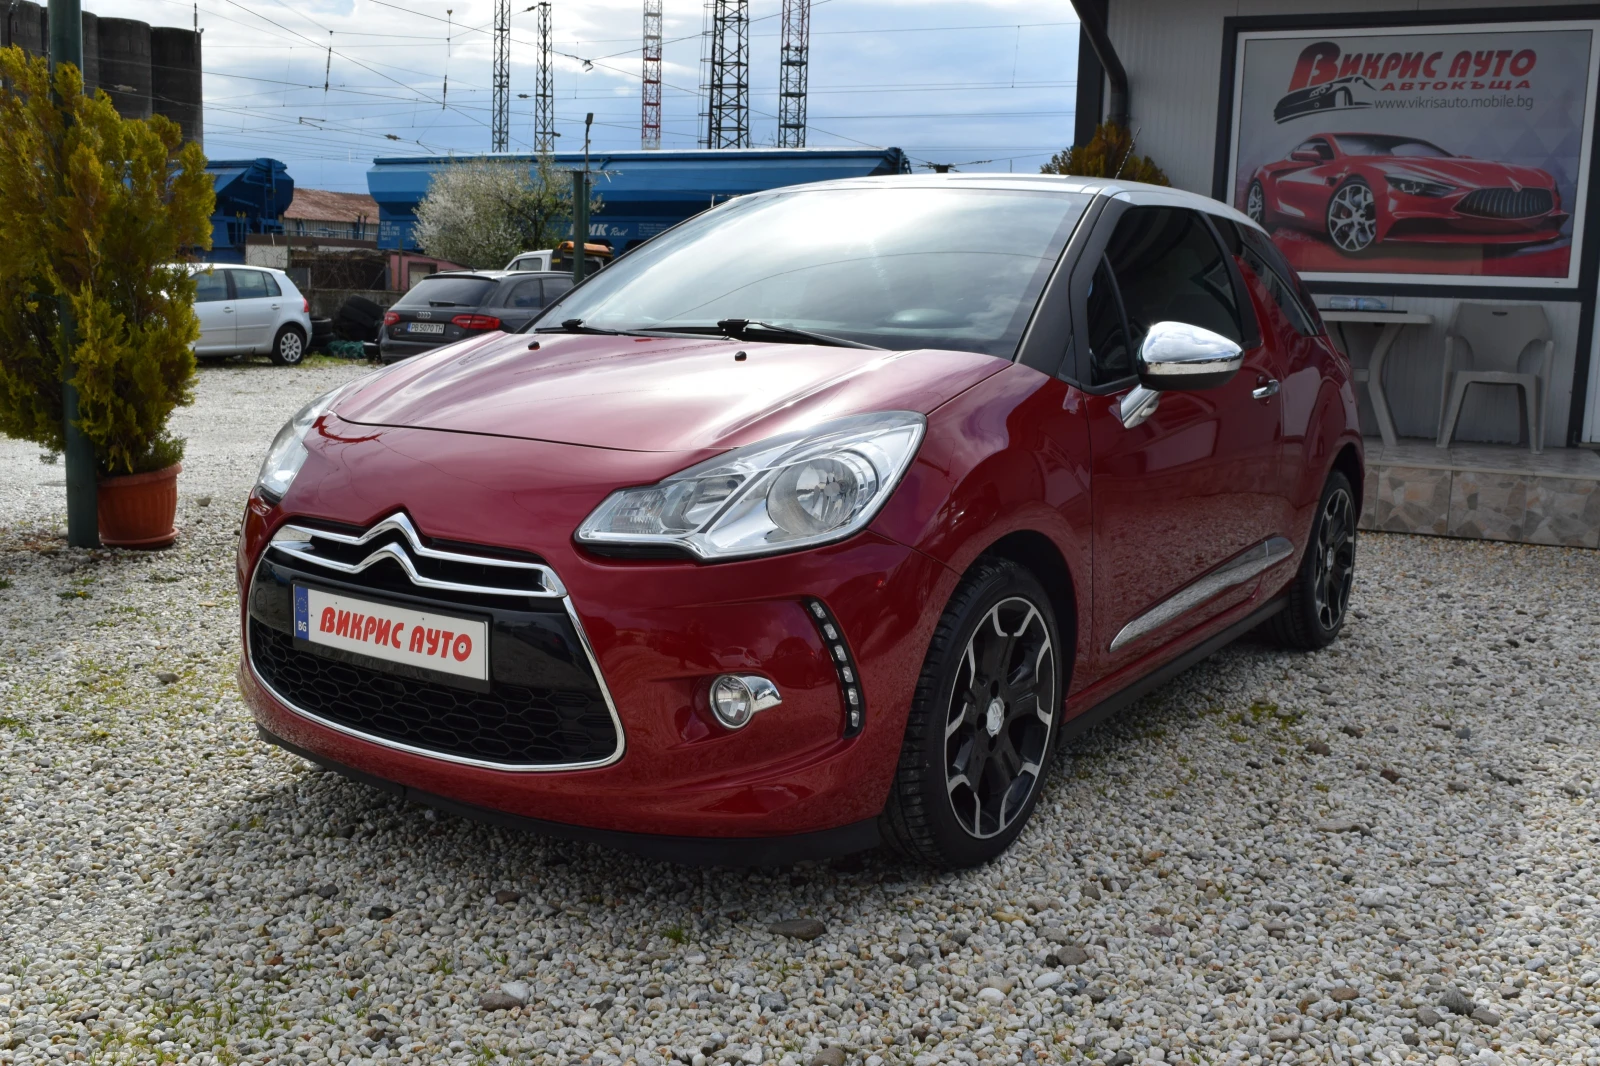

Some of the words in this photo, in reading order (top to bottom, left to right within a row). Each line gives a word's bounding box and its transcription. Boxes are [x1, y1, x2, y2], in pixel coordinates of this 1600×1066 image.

[1448, 49, 1537, 78] АУТО
[1380, 80, 1531, 91] АВТОКЪЩА
[1374, 95, 1534, 110] www.vikrisauto.mobile.bg
[609, 227, 628, 236] Rail
[419, 323, 435, 332] 5070
[298, 621, 307, 632] BG
[320, 606, 404, 649] ВИКРИС
[409, 625, 473, 662] АУТО
